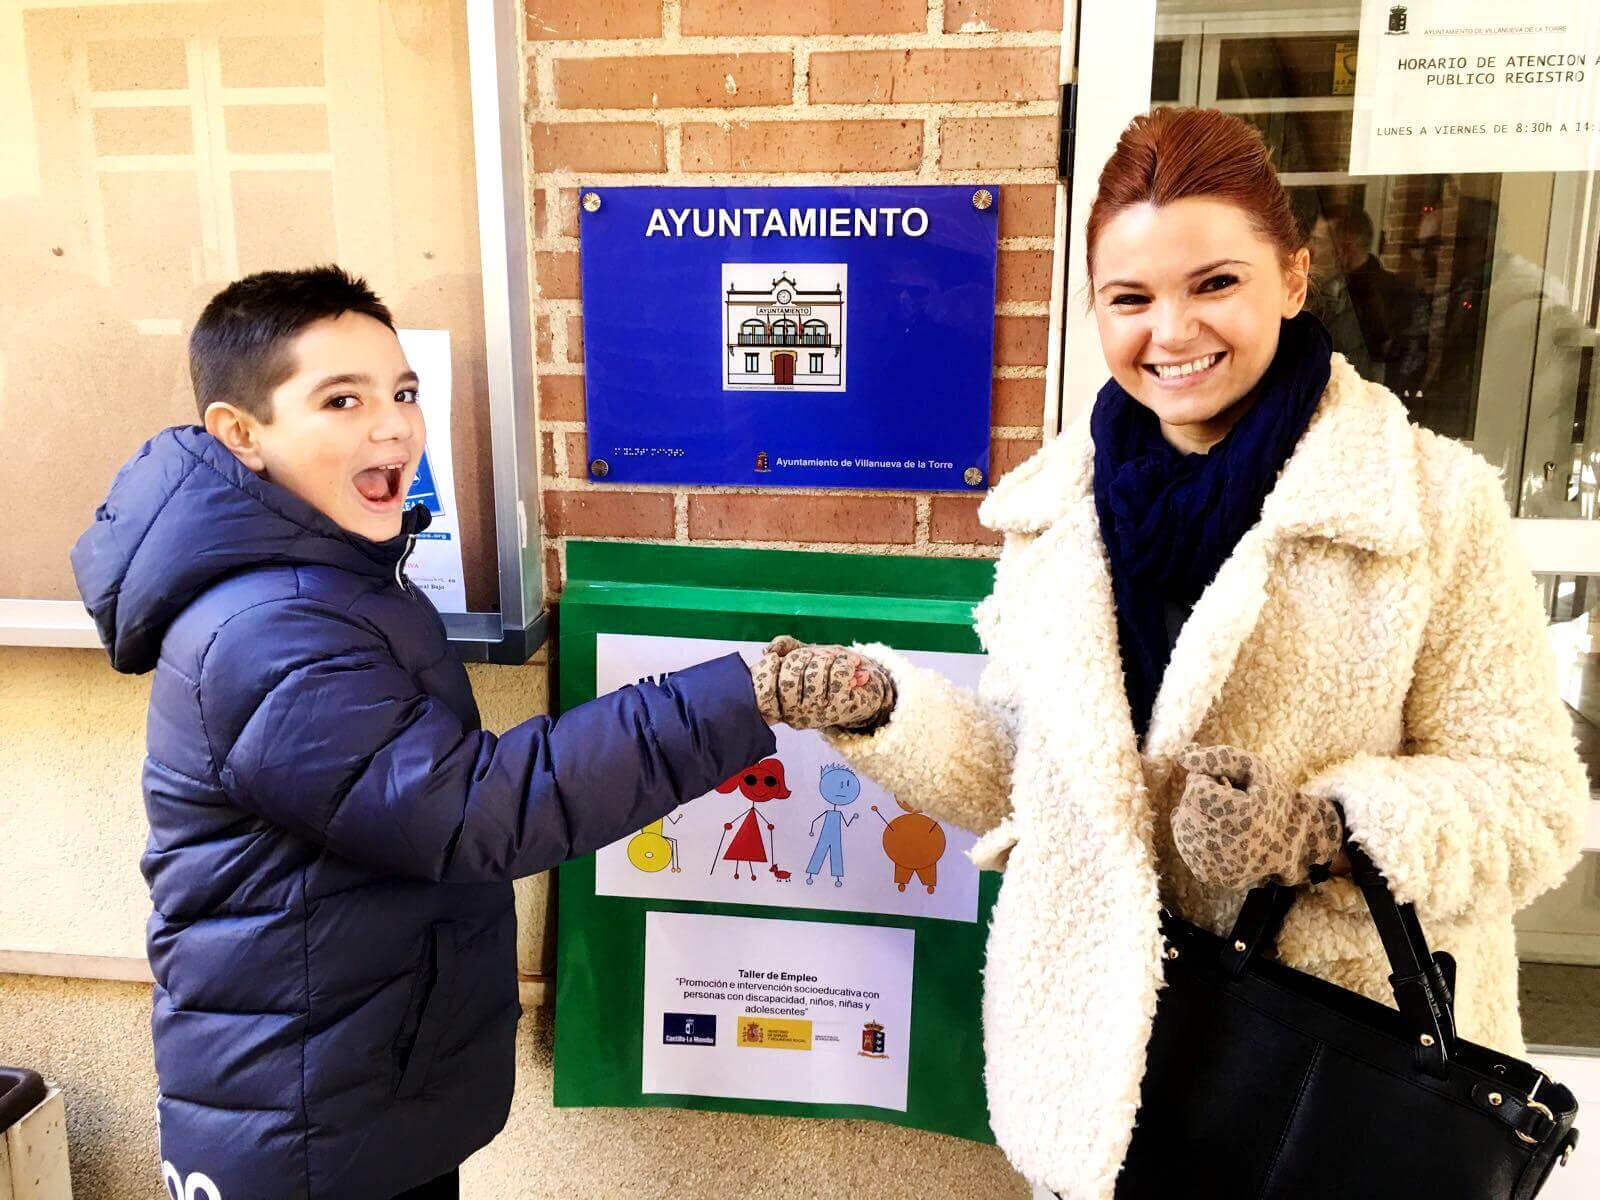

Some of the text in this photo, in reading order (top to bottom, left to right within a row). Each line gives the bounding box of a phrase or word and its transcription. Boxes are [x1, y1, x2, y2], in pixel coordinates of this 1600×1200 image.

[1398, 57, 1467, 70] HORARIO
[1477, 56, 1496, 68] DE
[1505, 54, 1586, 67] ATENCION
[1426, 70, 1585, 86] PUBLICO REGISTRO
[1377, 126, 1413, 136] LUNES
[1419, 126, 1427, 135] A
[1435, 124, 1486, 135] VIERNES
[1493, 124, 1509, 134] DE
[1515, 122, 1553, 133] 8:30h
[1560, 123, 1568, 132] A
[645, 206, 929, 238] AYUNTAMIENTO
[776, 457, 953, 469] Ayuntamiento de Villanueva de la Torre
[738, 969, 818, 983] Taller de Empleo
[729, 981, 736, 989] e
[737, 981, 793, 994] intervención
[794, 985, 862, 997] socioeducativa
[862, 990, 880, 1000] con
[683, 990, 871, 1011] personas con discapacidad, niños, niñas y
